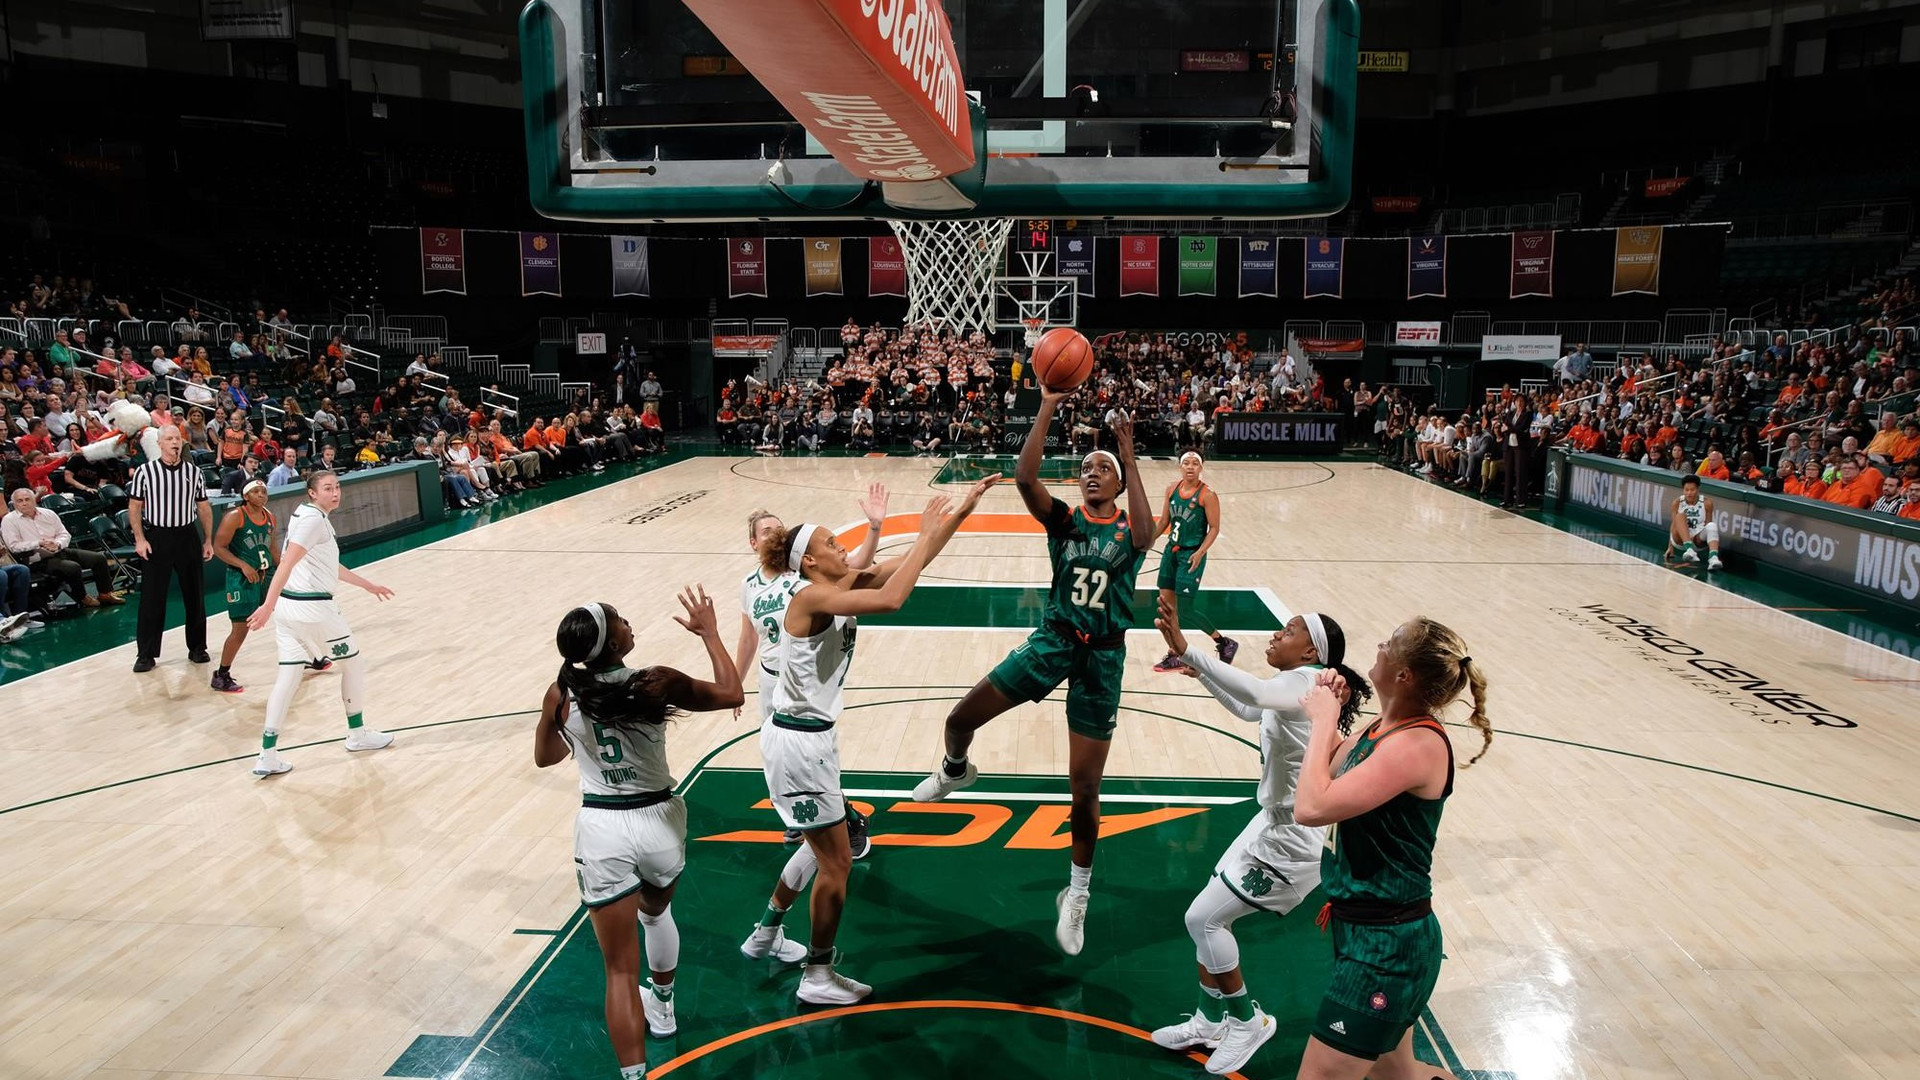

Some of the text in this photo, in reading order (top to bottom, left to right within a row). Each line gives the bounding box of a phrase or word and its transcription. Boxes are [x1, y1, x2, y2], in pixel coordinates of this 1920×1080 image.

[1028, 220, 1049, 231] 5:25
[1032, 232, 1046, 248] 14
[527, 258, 553, 266] CLEMSON
[581, 335, 603, 352] EXIT
[1397, 328, 1440, 340] ESPN
[1224, 421, 1336, 442] MUSCLE MILK
[1572, 466, 1665, 526] MUSCLE MILK
[1731, 514, 1779, 547] FEELS
[258, 550, 271, 571] 5
[1062, 537, 1129, 569] MIAMI
[1070, 566, 1110, 610] 32
[753, 592, 786, 617] Irish
[763, 616, 781, 644] 3
[1549, 606, 1792, 726] COOLING THE AMERICAS
[1686, 658, 1858, 729] CENTER
[592, 722, 624, 764] 5
[601, 766, 638, 785] YOUNG
